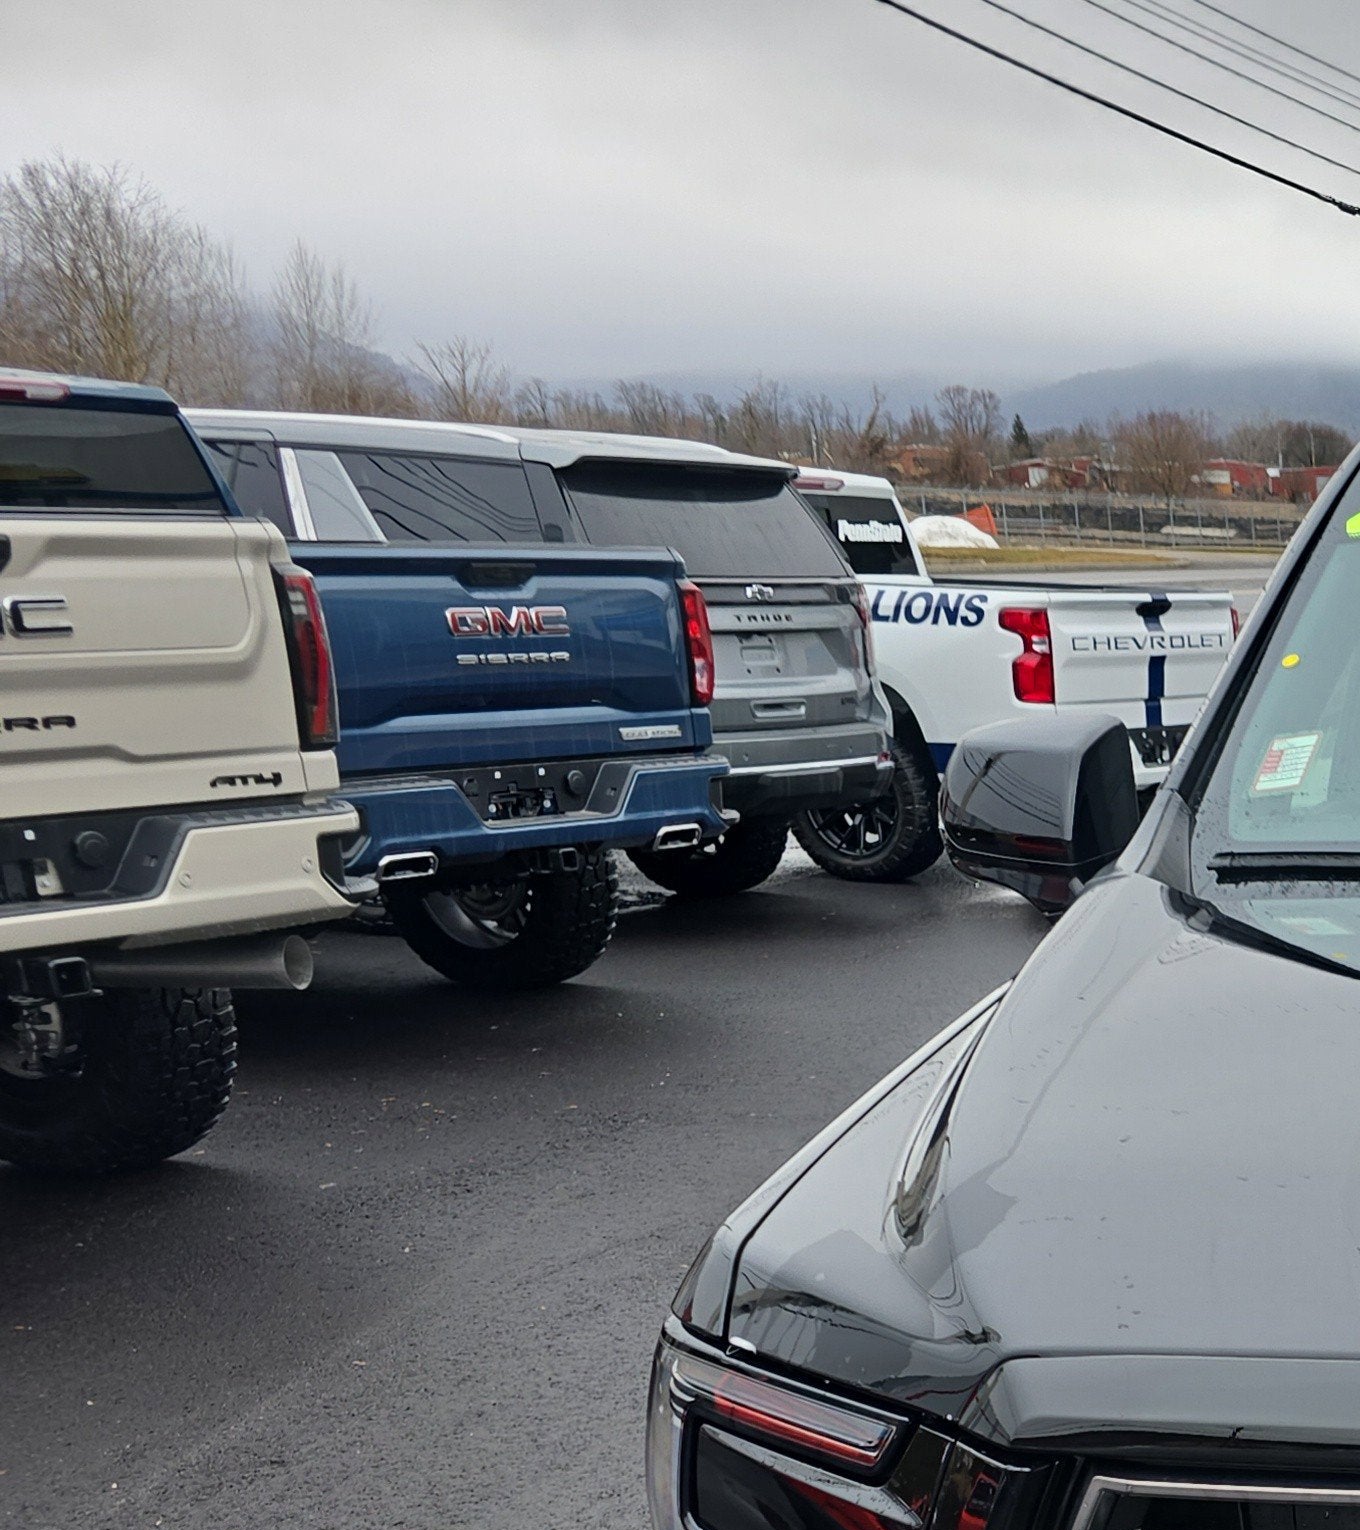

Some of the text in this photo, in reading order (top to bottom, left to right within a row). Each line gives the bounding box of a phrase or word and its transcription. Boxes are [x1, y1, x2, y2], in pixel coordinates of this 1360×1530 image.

[871, 590, 989, 628] LIONS
[445, 605, 570, 638] GMC
[734, 613, 794, 623] TAHOE
[1071, 633, 1227, 651] CHEVROLET
[456, 651, 570, 665] SIERRA
[209, 771, 283, 788] AT4
